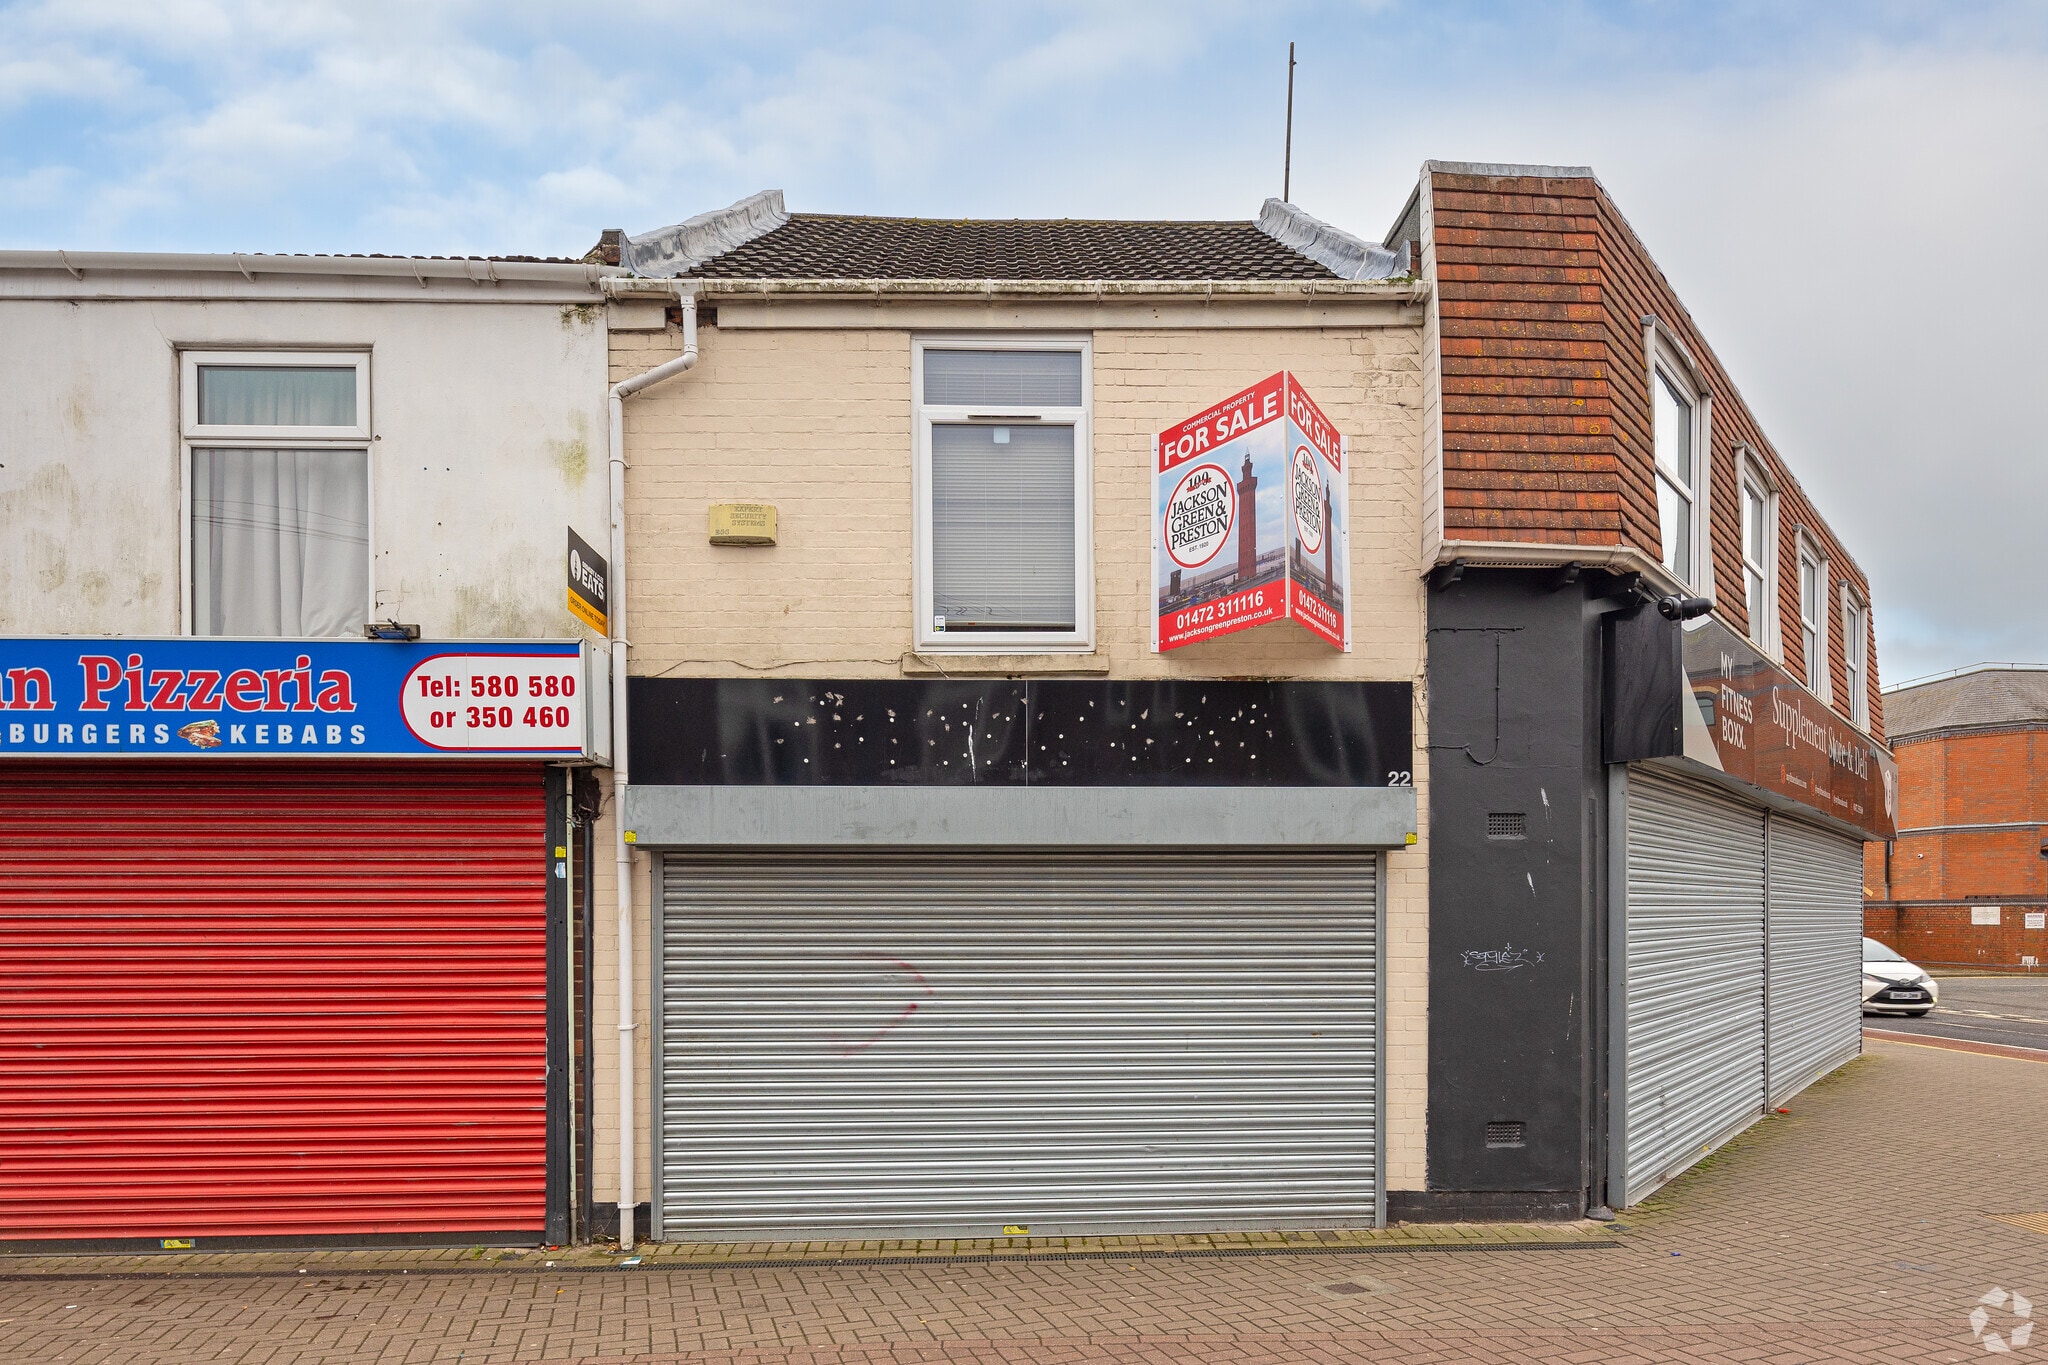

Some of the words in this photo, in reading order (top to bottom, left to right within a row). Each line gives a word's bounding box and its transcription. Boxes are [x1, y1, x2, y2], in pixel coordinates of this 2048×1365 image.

[1164, 426, 1210, 467] FOR
[1215, 390, 1278, 442] SALE
[1182, 409, 1221, 433] COMMERCIAL
[1222, 391, 1256, 413] PROPERTY
[1291, 390, 1313, 437] FOR
[1314, 420, 1339, 467] SALE
[1171, 480, 1228, 519] JACKSON
[1295, 463, 1321, 503] JACKSON
[729, 512, 768, 520] SECURITY
[731, 519, 766, 527] SYSTEMS
[1171, 503, 1215, 533] GREEN
[1215, 499, 1227, 517] &
[1171, 514, 1229, 551] PRESTON
[1295, 497, 1321, 536] PRESTON
[582, 568, 605, 601] EATS
[1168, 606, 1274, 643] www.jacksongreenpreston.co.uk
[1177, 605, 1214, 629] 01472
[1218, 590, 1264, 618] 311116
[1298, 589, 1317, 616] 01472
[1317, 603, 1337, 629] 311116
[0, 666, 57, 711] n
[78, 652, 358, 713] Pizzeria
[1720, 651, 1734, 682] MY
[417, 675, 461, 698] Tel:
[471, 675, 519, 698] 580
[528, 675, 576, 698] 580
[1721, 683, 1753, 724] FITNESS
[9, 723, 170, 745] BURGERS
[230, 723, 366, 745] KEBABS
[430, 710, 457, 729] or
[466, 706, 513, 729] 350
[522, 706, 570, 729] 460
[1722, 715, 1747, 750] BOXX.
[1772, 685, 1828, 755] Supplement
[1828, 726, 1846, 767] Store
[1846, 741, 1854, 773] &
[1854, 744, 1868, 781] Deli
[1387, 771, 1412, 788] 22
